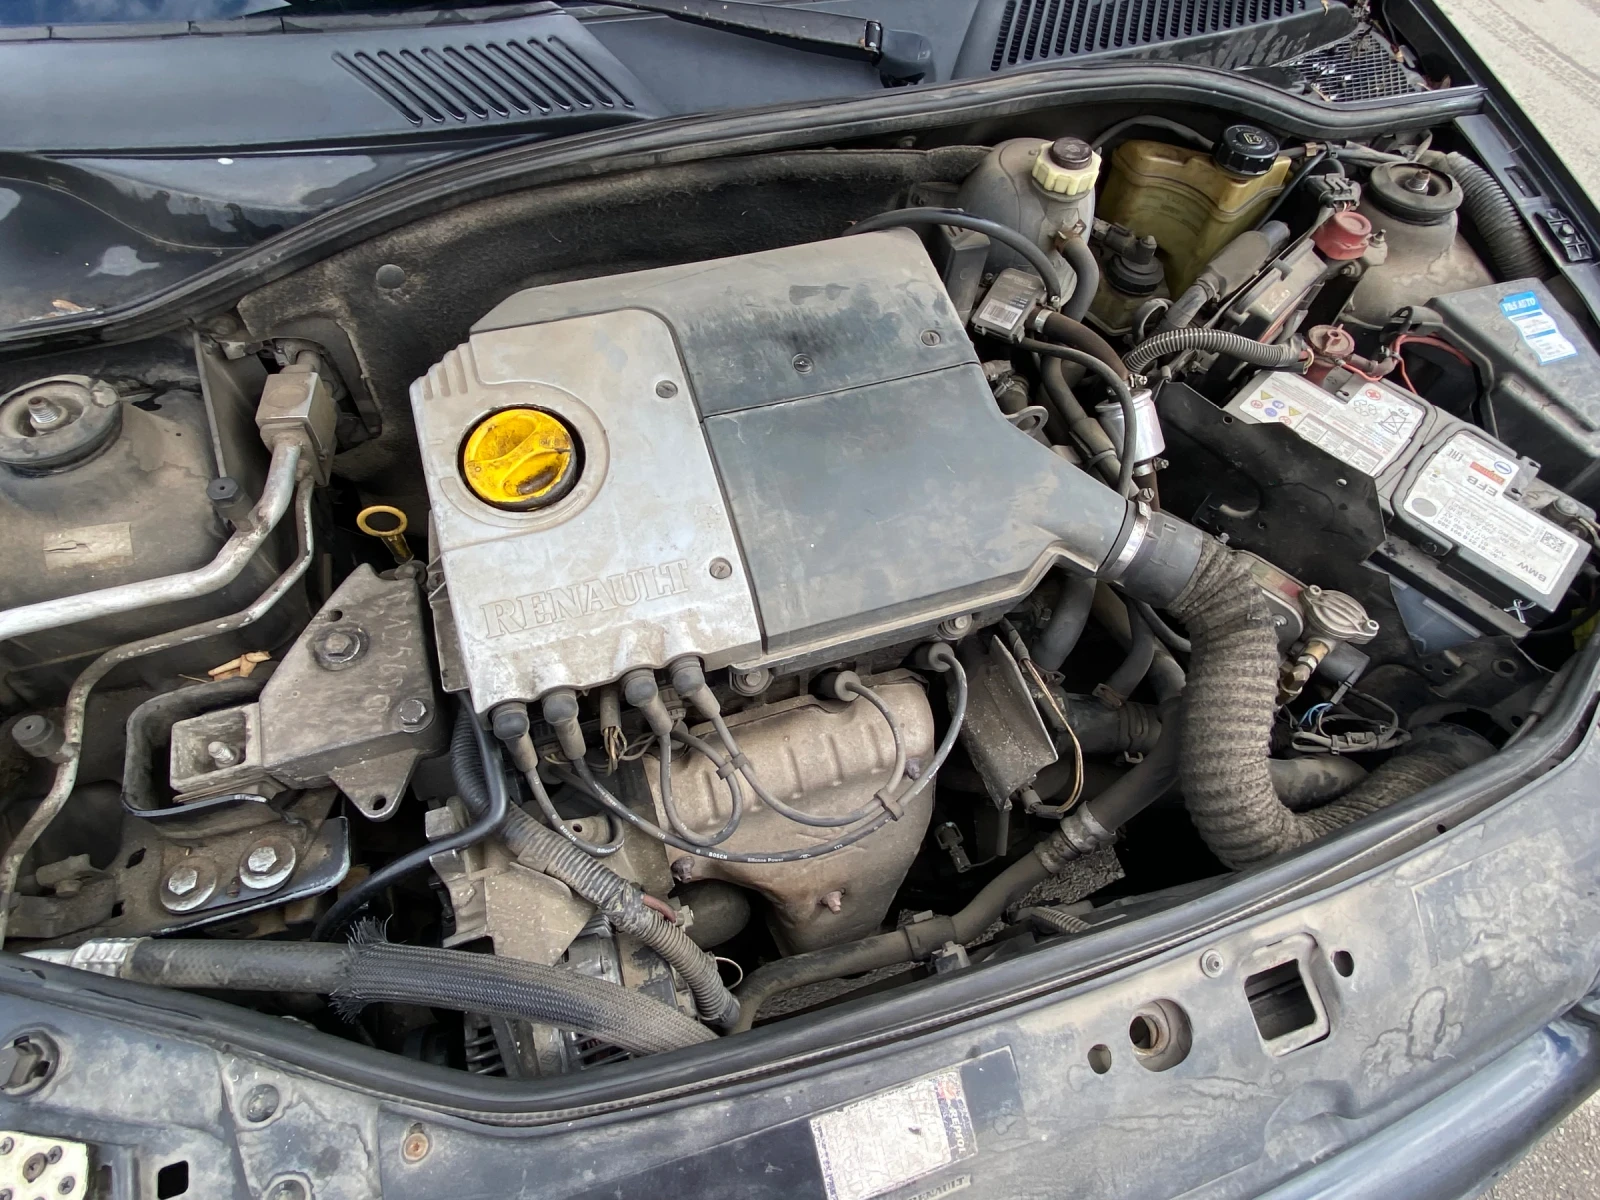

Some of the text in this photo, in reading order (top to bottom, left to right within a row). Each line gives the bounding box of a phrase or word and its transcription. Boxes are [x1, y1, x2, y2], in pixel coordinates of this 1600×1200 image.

[1397, 406, 1413, 417] Pb
[1467, 475, 1498, 497] EFB
[1517, 562, 1546, 582] BMW
[479, 559, 689, 640] RENAULT
[560, 825, 577, 842] BOSCH
[708, 851, 728, 860] BOSCH
[951, 1106, 967, 1154] REPSOL
